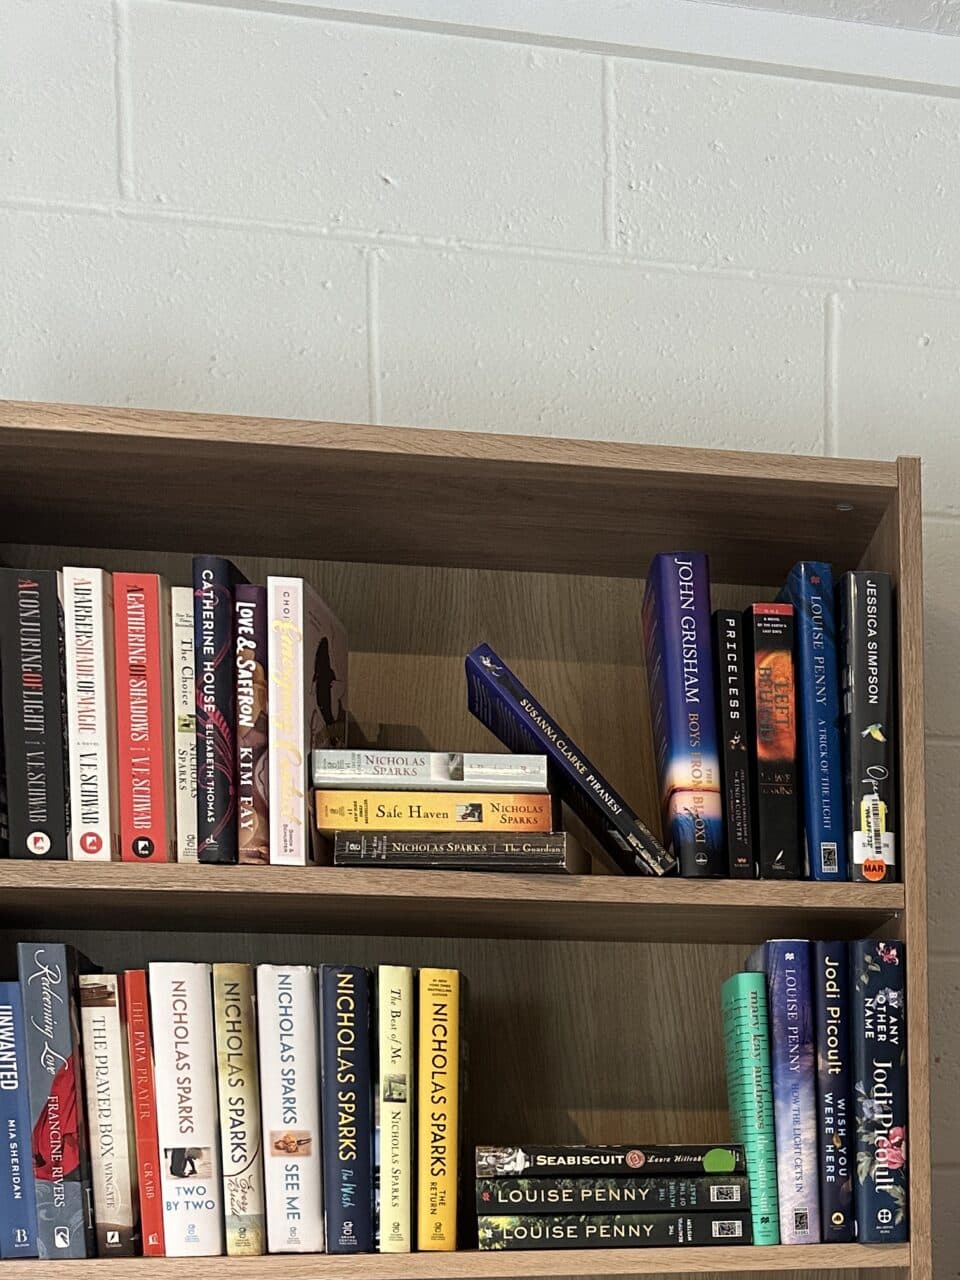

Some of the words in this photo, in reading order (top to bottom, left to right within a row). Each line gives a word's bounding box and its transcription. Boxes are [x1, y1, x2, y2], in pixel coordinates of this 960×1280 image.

[675, 557, 694, 610] JOHN
[866, 580, 878, 637] JESSICA
[202, 569, 214, 656] CATHERINE
[811, 596, 824, 649] LOUISE
[680, 616, 700, 704] GRISHAM
[725, 618, 740, 719] PRICELESS
[814, 655, 827, 707] PENNY
[867, 640, 879, 704] SIMPSON
[203, 661, 215, 712] HOUSE
[205, 724, 215, 778] ELISABETH
[520, 698, 557, 741] SUSANNA
[556, 740, 587, 775] CLARKE
[586, 773, 622, 816] PIRANESI
[206, 781, 216, 823] THOMAS
[375, 804, 403, 819] Safe
[408, 805, 449, 820] Haven
[785, 969, 799, 1023] LOUISE
[825, 957, 840, 1000] Jodi
[889, 991, 898, 1009] BY
[172, 980, 190, 1071] NICHOLAS
[224, 983, 244, 1088] NICHOLAS
[277, 974, 294, 1062] NICHOLAS
[337, 974, 354, 1083] NICHOLAS
[826, 1007, 841, 1075] Picoult
[865, 998, 875, 1039] NAME
[876, 995, 886, 1042] OTHER
[890, 1013, 899, 1045] ANY
[431, 1003, 447, 1104] NICHOLAS
[788, 1027, 801, 1073] PENNY
[176, 1076, 194, 1134] SPARKS
[281, 1069, 297, 1124] SPARKS
[873, 1059, 892, 1104] Jodi
[8, 1119, 16, 1139] MIA
[229, 1097, 248, 1164] SPARKS
[338, 1091, 356, 1161] SPARKS
[391, 1111, 401, 1166] NICHOLAS
[825, 1092, 834, 1135] WERE
[838, 1098, 846, 1137] WISH
[10, 1142, 22, 1199] SHERIDAN
[431, 1112, 447, 1177] SPARKS
[536, 1155, 624, 1166] SEABISCUIT
[826, 1145, 835, 1183] HERE
[839, 1150, 847, 1177] YOU
[874, 1111, 894, 1193] Picoult
[175, 1186, 207, 1196] TWO
[285, 1164, 299, 1191] SEE
[392, 1169, 401, 1208] SPARKS
[498, 1189, 573, 1203] LOUISE
[580, 1188, 650, 1202] PENNY
[166, 1200, 181, 1211] BY
[184, 1200, 216, 1211] TWO
[287, 1197, 300, 1220] ME
[503, 1225, 578, 1240] LOUISE
[586, 1224, 654, 1238] PENNY
